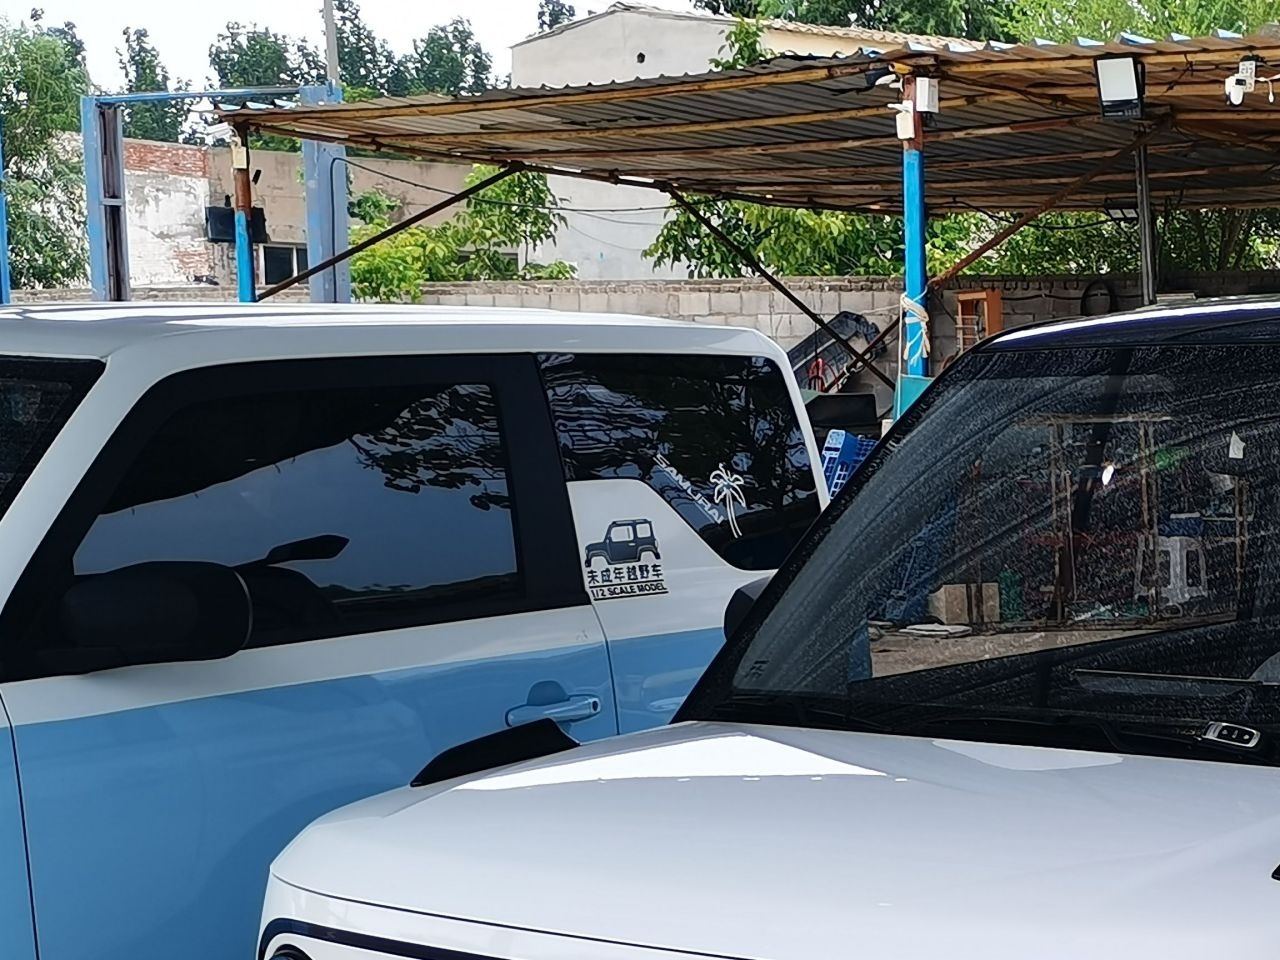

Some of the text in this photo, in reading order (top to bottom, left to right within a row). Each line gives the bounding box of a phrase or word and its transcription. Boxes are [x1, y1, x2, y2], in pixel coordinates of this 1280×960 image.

[653, 453, 724, 524] SAMURAI
[587, 564, 663, 585] 未成年越野车
[607, 586, 636, 596] SCALE
[637, 582, 667, 593] MODEL
